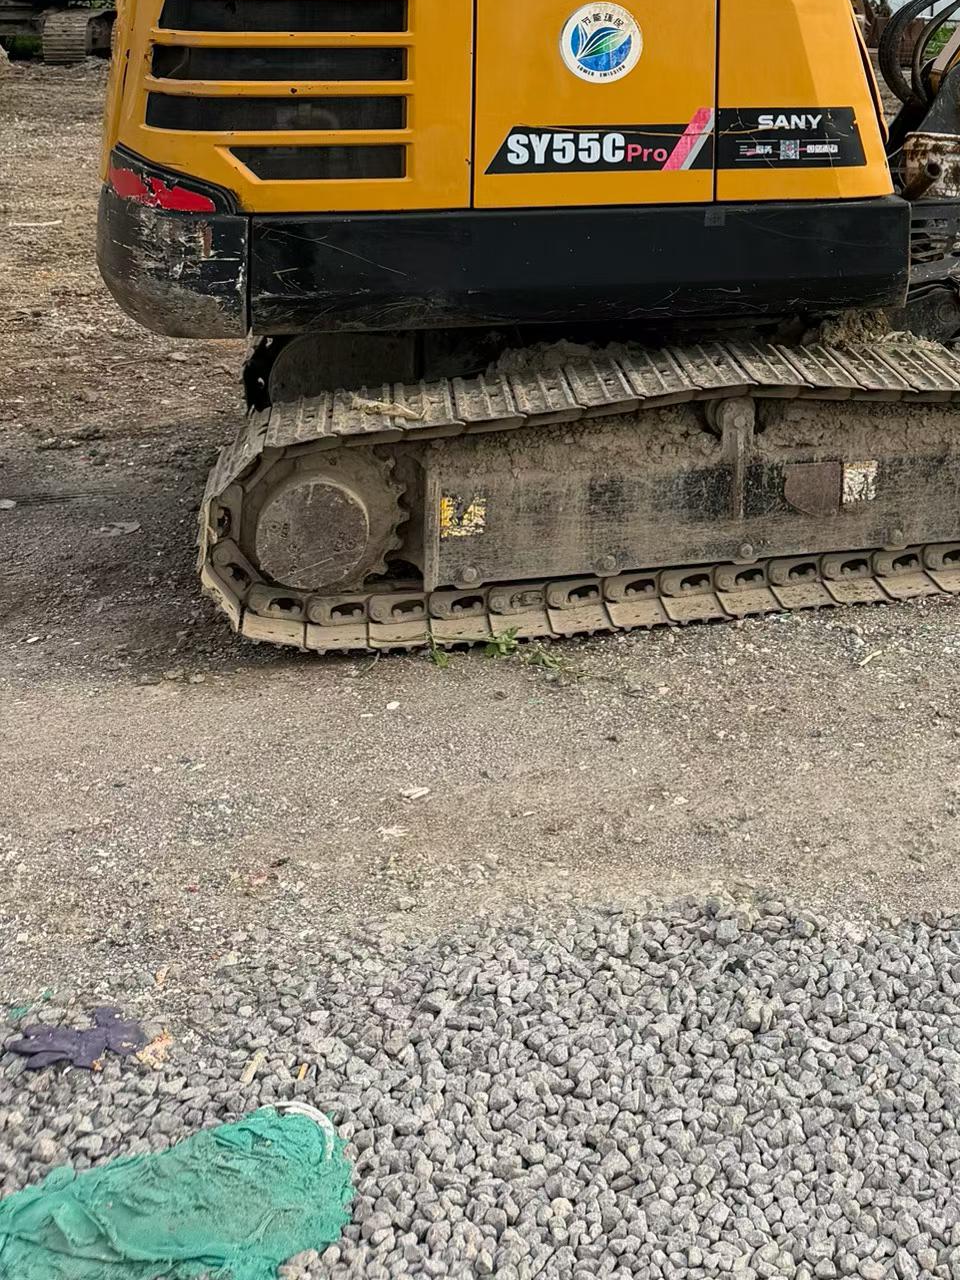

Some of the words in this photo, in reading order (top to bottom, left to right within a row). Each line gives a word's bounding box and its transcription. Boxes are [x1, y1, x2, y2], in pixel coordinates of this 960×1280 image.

[757, 114, 823, 130] SANY
[506, 132, 626, 165] SY55C
[626, 143, 668, 163] Pro
